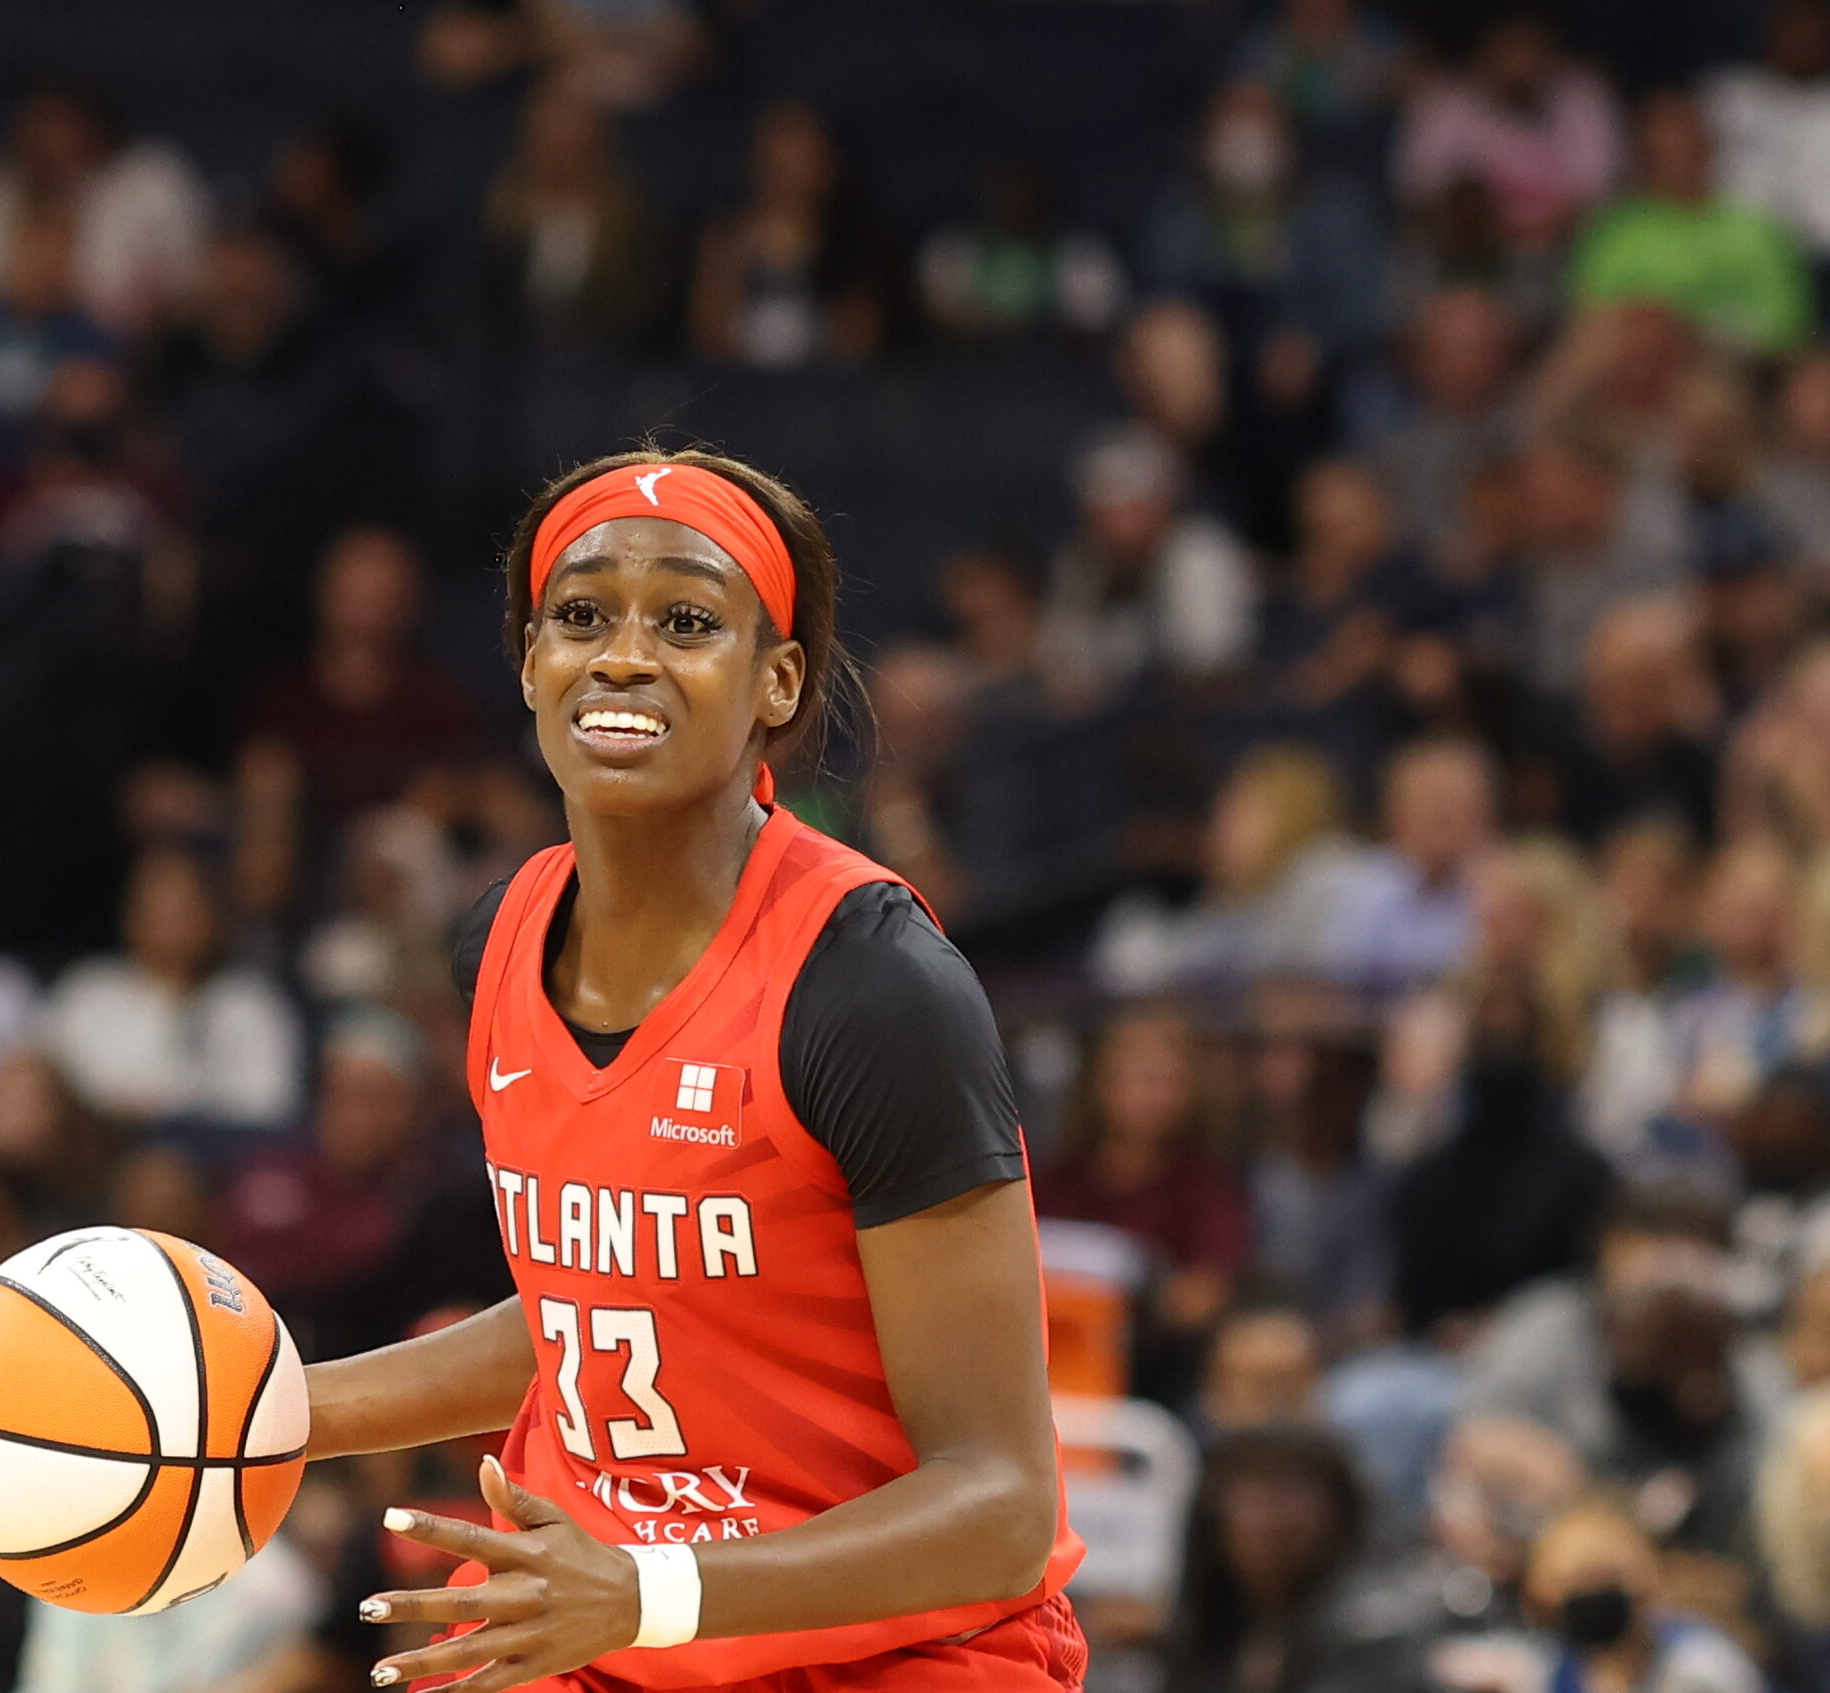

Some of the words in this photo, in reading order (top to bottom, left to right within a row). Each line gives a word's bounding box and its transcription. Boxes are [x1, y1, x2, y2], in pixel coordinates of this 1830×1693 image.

[650, 1116, 736, 1147] Microsoft
[485, 1159, 759, 1281] TLANTA
[539, 1296, 689, 1463] 33
